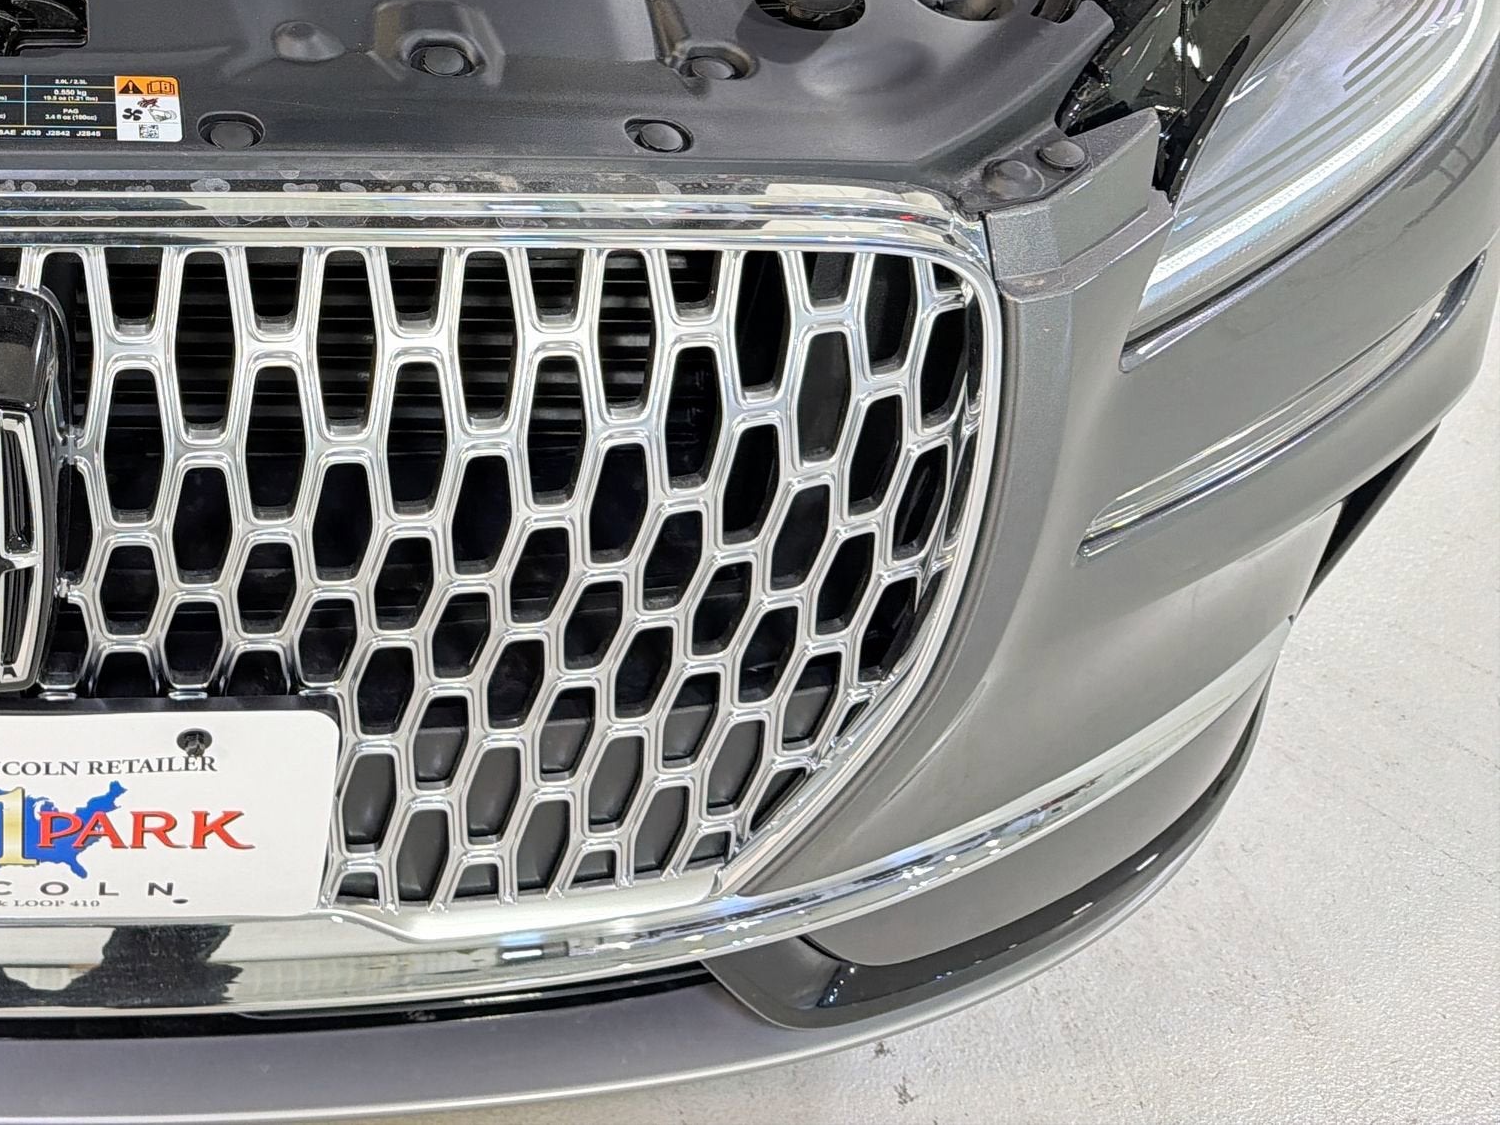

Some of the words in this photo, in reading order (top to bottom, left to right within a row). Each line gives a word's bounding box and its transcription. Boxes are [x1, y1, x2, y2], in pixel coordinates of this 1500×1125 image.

[76, 89, 88, 97] kg
[87, 756, 217, 775] RETAILER
[37, 810, 256, 850] PARK
[14, 899, 65, 907] LOOP
[70, 899, 100, 907] 410
